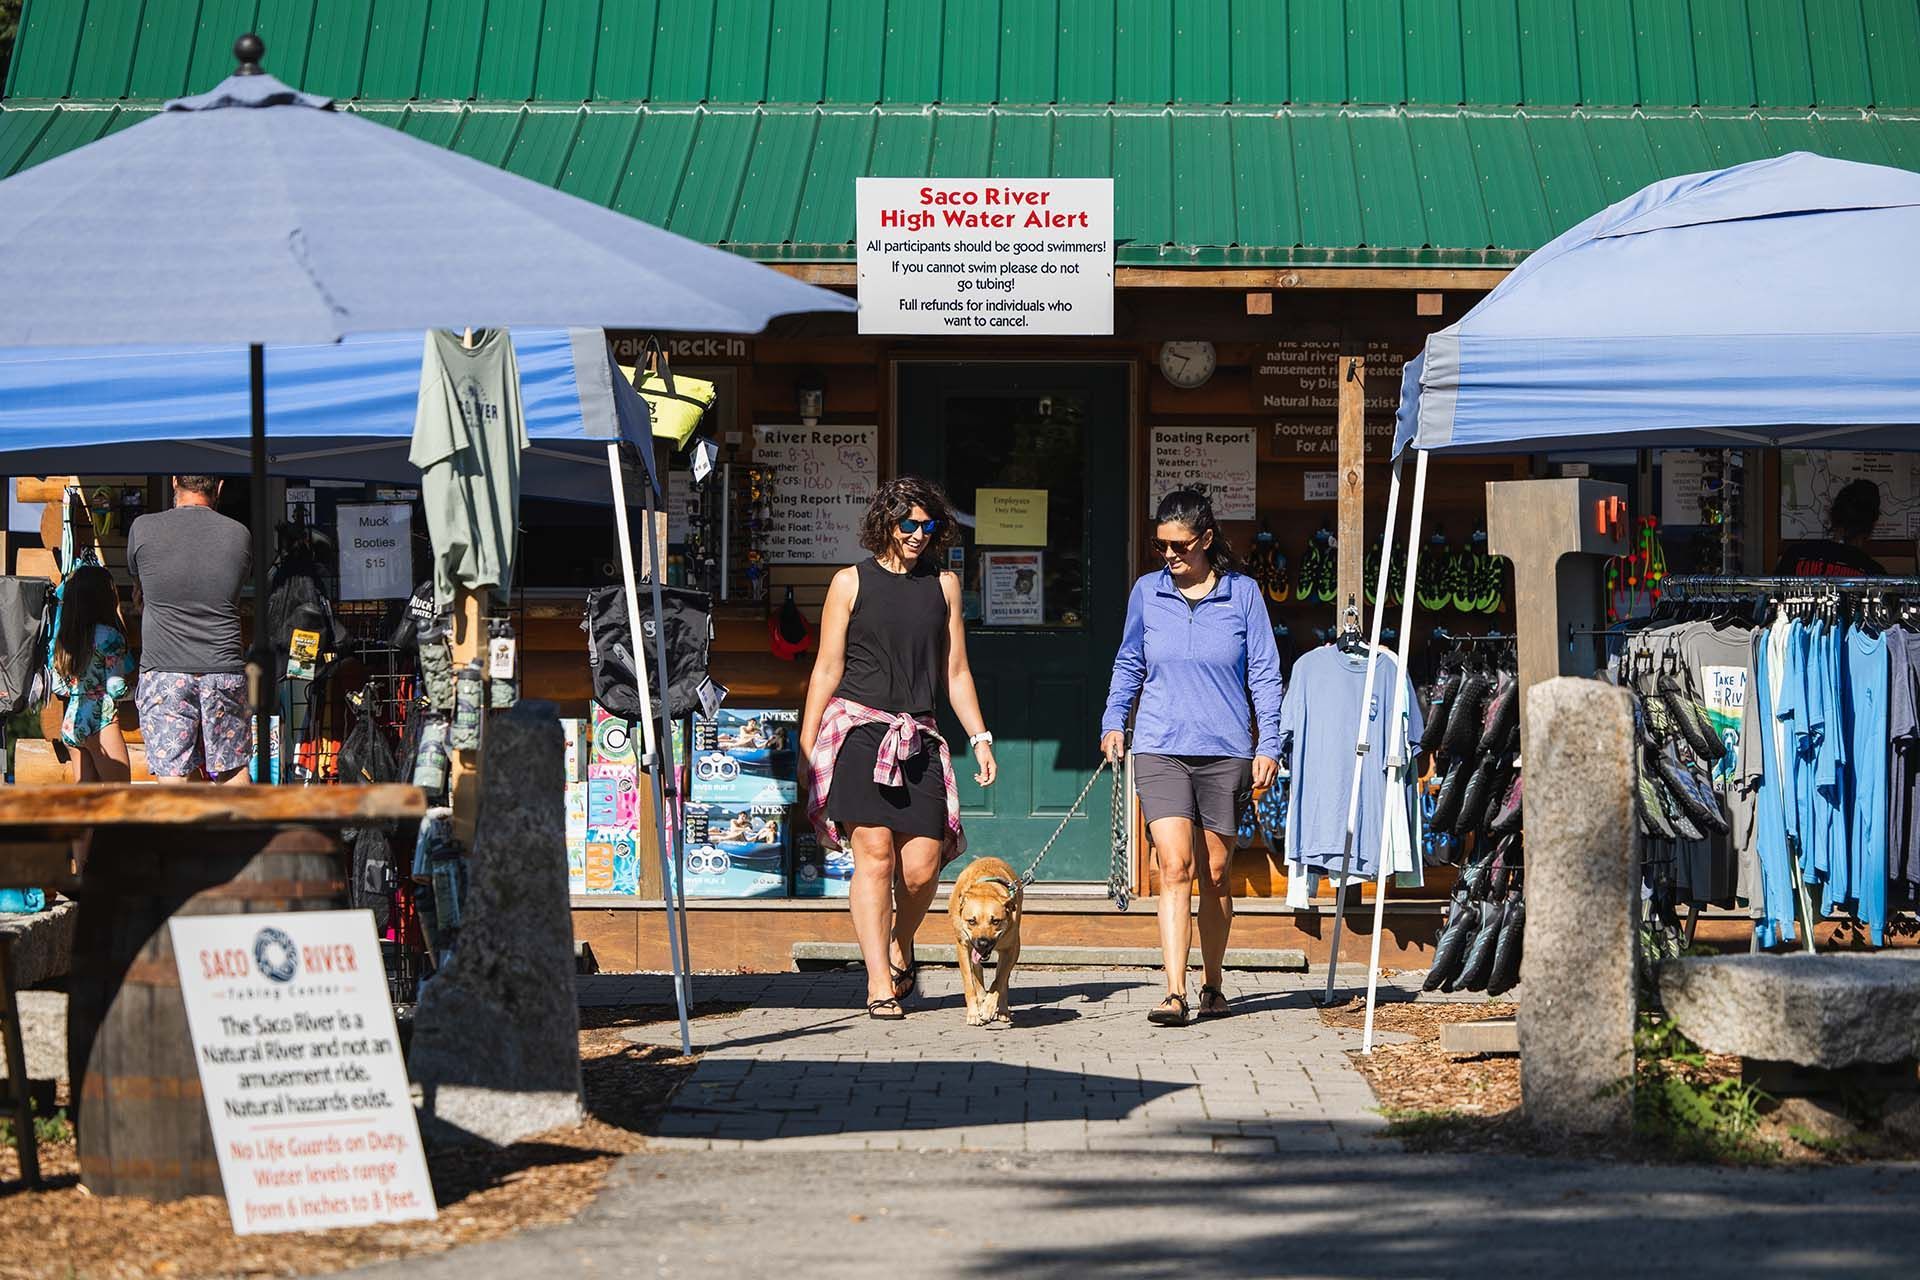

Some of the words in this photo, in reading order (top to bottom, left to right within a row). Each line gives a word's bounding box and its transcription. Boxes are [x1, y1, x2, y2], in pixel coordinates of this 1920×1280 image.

[920, 187, 978, 205] Saco
[985, 187, 1050, 205] River
[881, 209, 935, 231] High
[943, 210, 1016, 228] Water
[1023, 210, 1089, 228] Alert
[866, 240, 881, 252] All
[884, 240, 951, 255] participants
[953, 240, 992, 252] should
[994, 240, 1010, 252] be
[1013, 240, 1044, 255] good
[1047, 240, 1107, 252] swimmers!
[891, 260, 900, 273] If
[902, 264, 924, 277] you
[926, 262, 966, 273] cannot
[967, 261, 997, 274] swim
[1000, 262, 1038, 277] please
[1040, 261, 1057, 274] do
[1060, 262, 1080, 274] not
[957, 279, 973, 292] go
[976, 277, 1015, 293] tubing!
[899, 299, 917, 311] Full
[920, 299, 963, 311] refunds
[966, 299, 983, 311] for
[985, 299, 1045, 312] individuals
[1047, 300, 1073, 312] who
[944, 317, 971, 327] want
[974, 317, 987, 327] to
[989, 315, 1029, 327] cancel.
[1266, 350, 1308, 362] natural
[1310, 350, 1339, 362] river
[1366, 351, 1387, 363] not
[1389, 353, 1403, 362] an
[1259, 365, 1327, 375] amusement
[1300, 378, 1316, 390] by
[1263, 395, 1309, 407] Natural
[1364, 396, 1400, 408] exist.
[1275, 423, 1333, 436] Footwear
[765, 431, 807, 444] River
[811, 431, 867, 446] Report
[1155, 432, 1203, 445] Boating
[1205, 432, 1250, 445] Report
[1156, 447, 1181, 456] Date:
[1296, 440, 1316, 452] For
[1319, 440, 1337, 453] All
[758, 449, 782, 458] Date:
[1157, 458, 1199, 467] Weather:
[1156, 470, 1182, 478] River
[1184, 469, 1202, 478] CFS:
[800, 494, 841, 506] Report
[993, 496, 1031, 506] Employees
[787, 509, 813, 519] Float:
[359, 517, 389, 527] Muck
[788, 523, 813, 532] Float:
[354, 538, 396, 549] Booties
[788, 536, 813, 545] Float:
[787, 550, 815, 560] Temp:
[365, 558, 386, 569] $15
[1713, 671, 1735, 687] TAKE
[760, 711, 797, 722] INTEX
[751, 804, 787, 815] INTEX
[200, 949, 249, 980] SACO
[303, 944, 359, 976] RIVER
[218, 1015, 251, 1036] The
[254, 1013, 293, 1035] Saco
[294, 1010, 334, 1031] River
[337, 1009, 352, 1030] is
[353, 1013, 364, 1029] a
[203, 1041, 262, 1064] Natural
[264, 1040, 304, 1062] River
[309, 1036, 340, 1058] and
[342, 1036, 368, 1056] not
[370, 1038, 393, 1056] an
[237, 1066, 334, 1090] amusement
[335, 1061, 372, 1083] ride.
[224, 1094, 284, 1118] Natural
[286, 1090, 348, 1114] hazards
[350, 1087, 395, 1110] exist.
[230, 1140, 254, 1161] No
[256, 1137, 285, 1162] Life
[287, 1133, 341, 1157] Guards
[344, 1135, 366, 1153] on
[367, 1130, 409, 1155] Duty.
[253, 1168, 302, 1188] Water
[305, 1161, 350, 1184] levels
[352, 1161, 398, 1185] range
[245, 1200, 284, 1225] from
[286, 1198, 298, 1217] 6
[300, 1195, 349, 1217] inches
[351, 1196, 369, 1212] to
[384, 1188, 421, 1214] feet.
